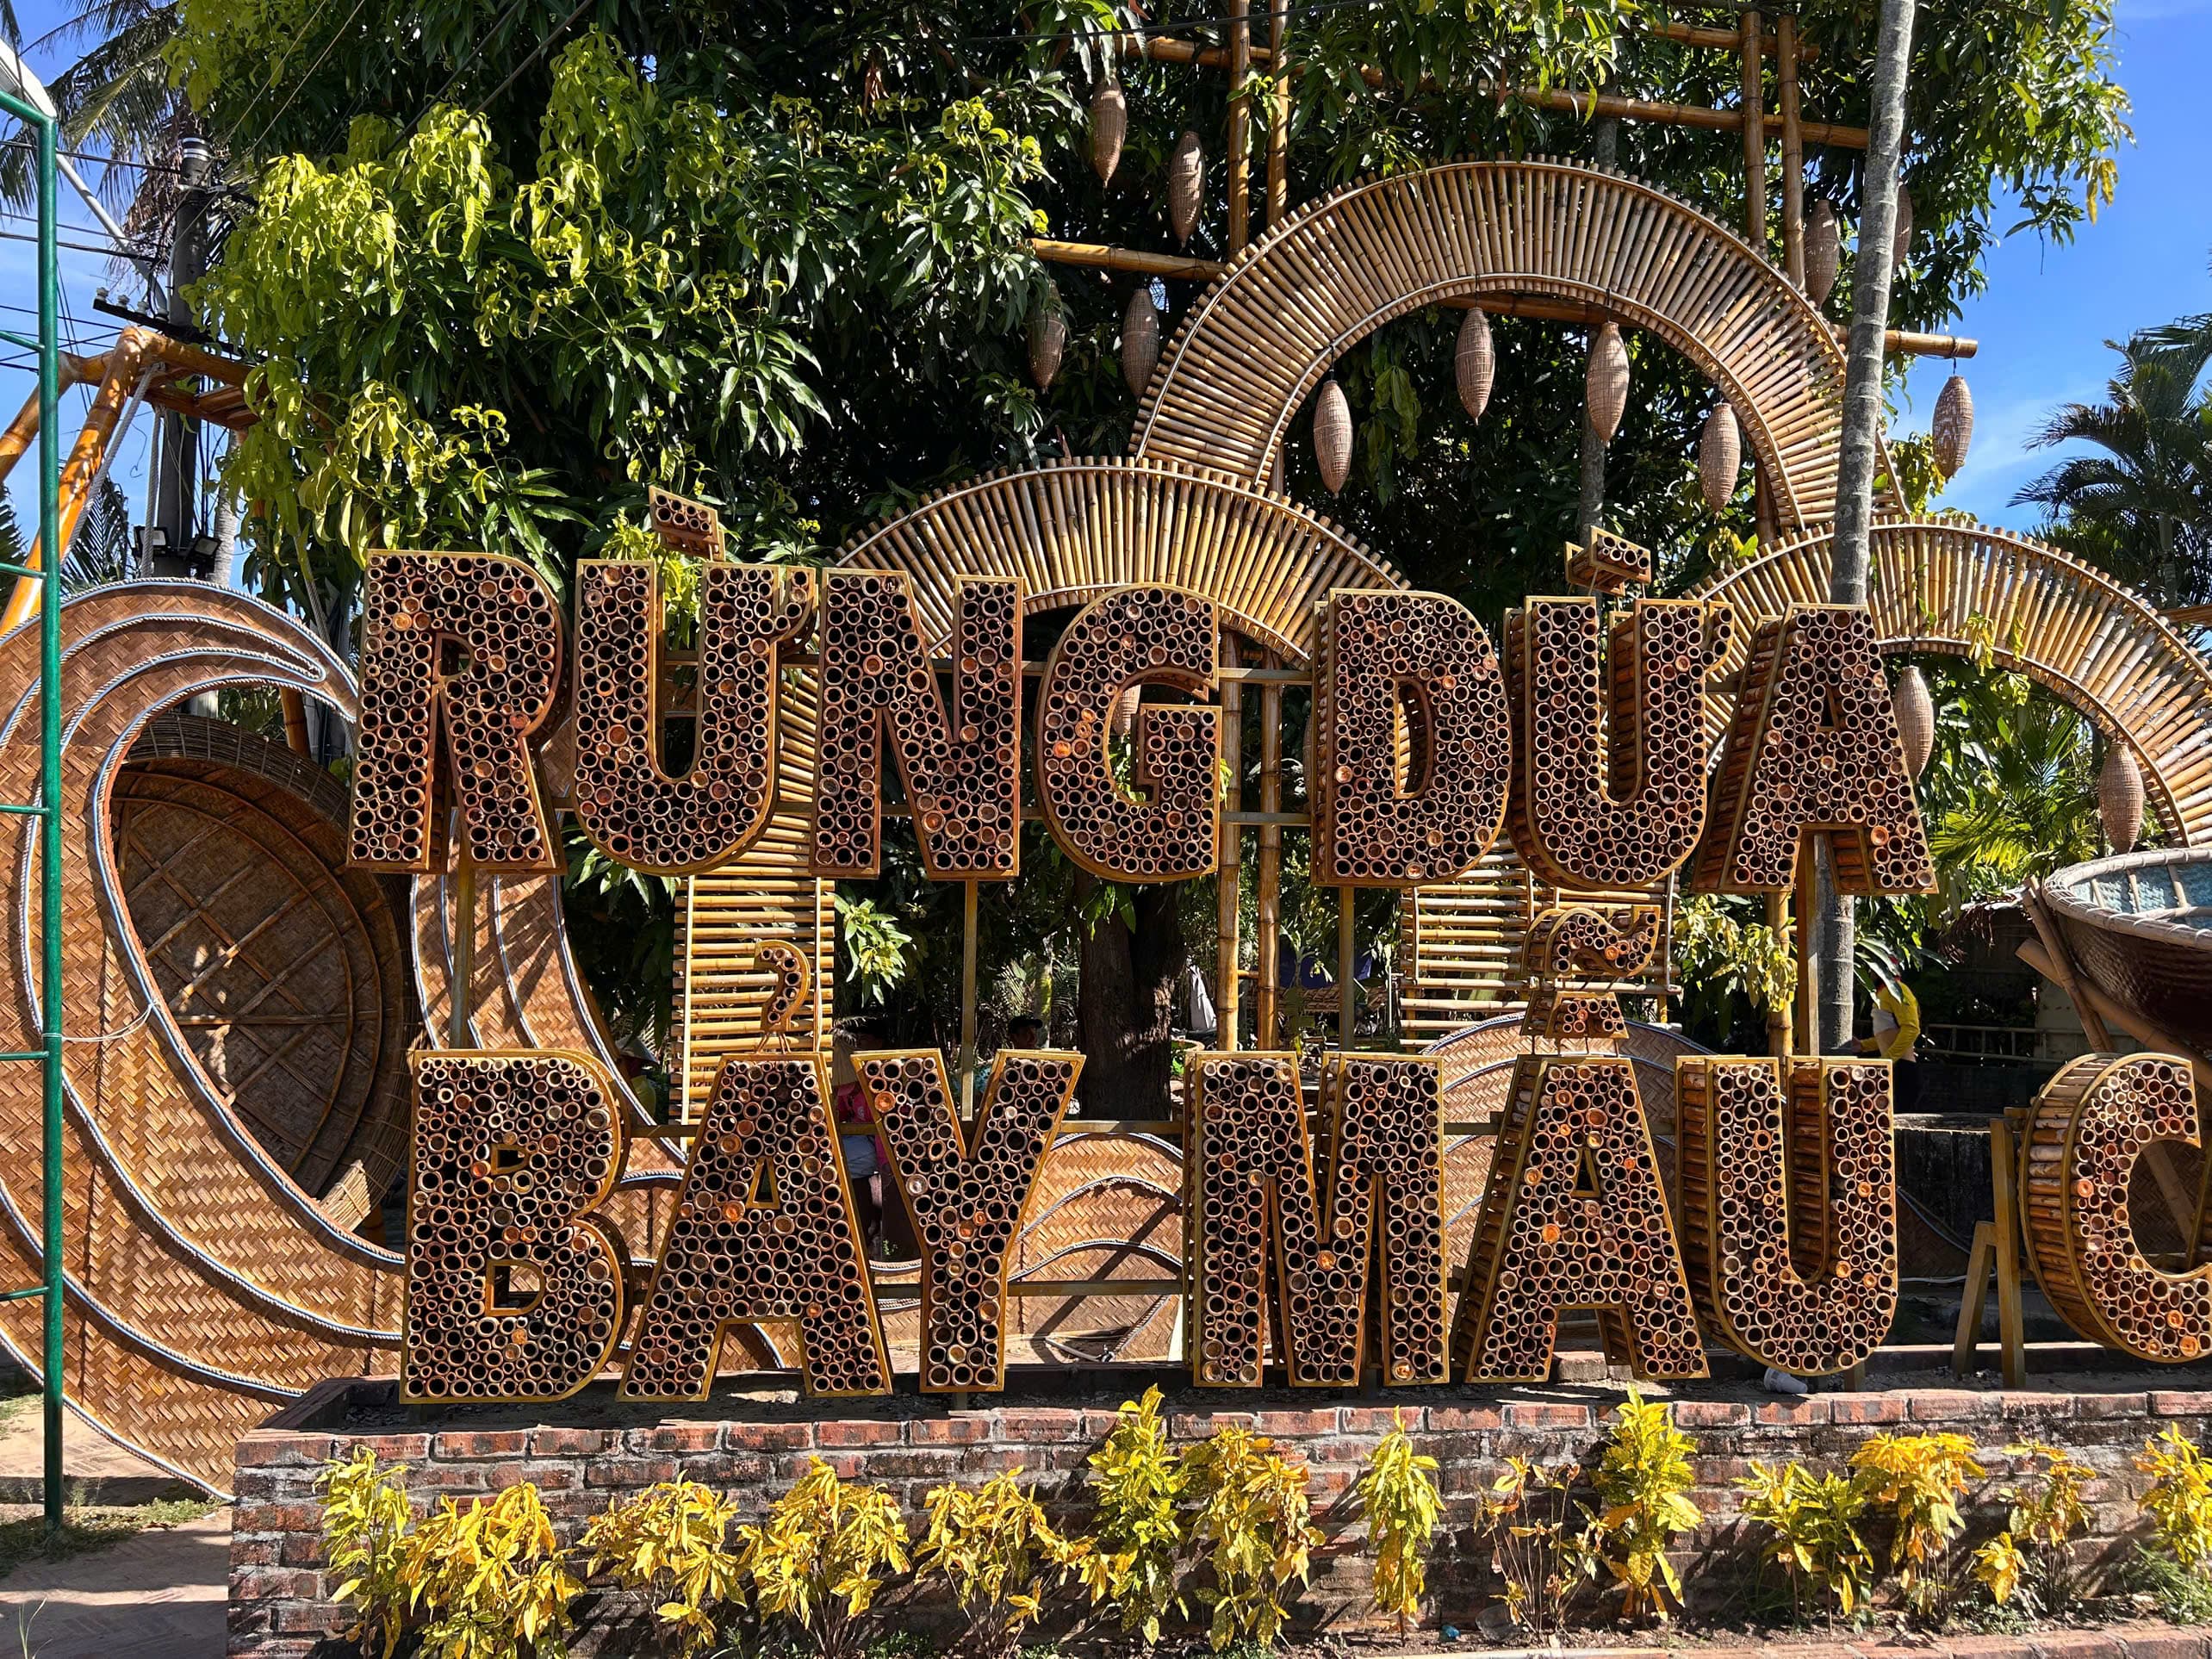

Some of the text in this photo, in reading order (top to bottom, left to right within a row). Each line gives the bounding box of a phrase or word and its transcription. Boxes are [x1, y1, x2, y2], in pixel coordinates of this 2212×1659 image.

[346, 487, 1938, 894] RỪNG DỪA
[400, 939, 1086, 1403] BẢY
[1184, 904, 1898, 1387] MẪU
